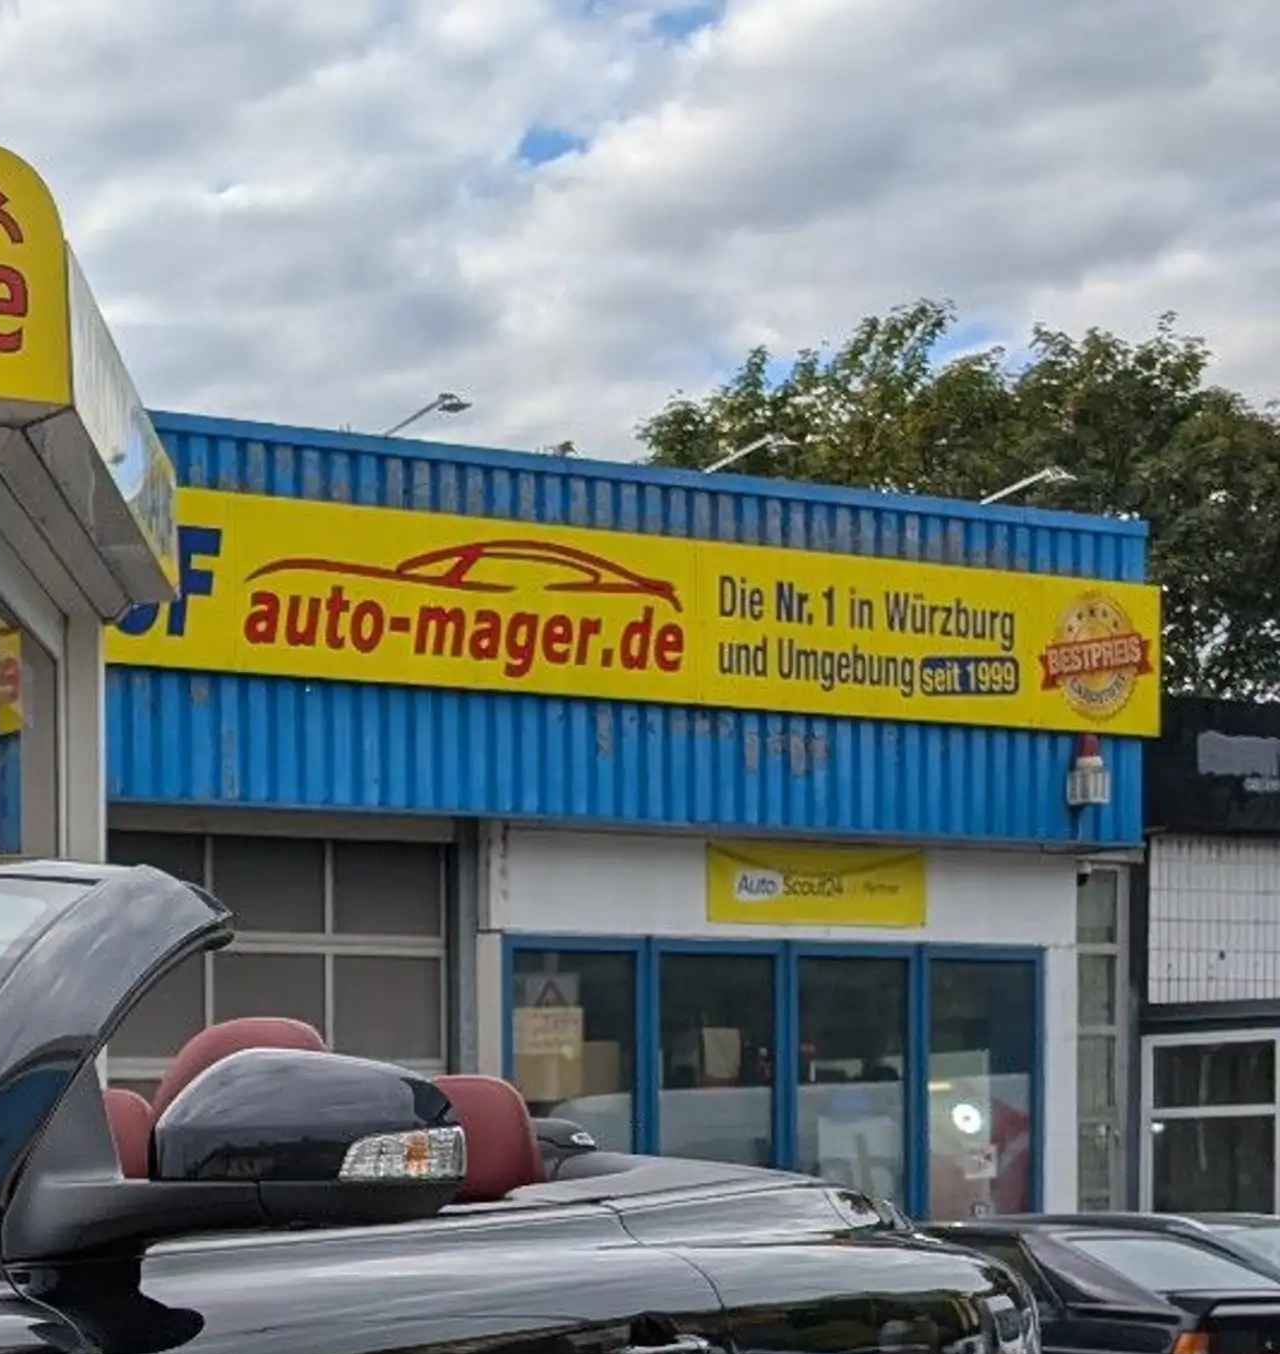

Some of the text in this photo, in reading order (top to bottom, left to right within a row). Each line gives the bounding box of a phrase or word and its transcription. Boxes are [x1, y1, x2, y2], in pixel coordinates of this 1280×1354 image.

[243, 583, 685, 678] auto-mager.de
[718, 575, 1016, 652] Die Nr. 1 in Würzburg
[718, 637, 1017, 697] und Umgebung seit 1999
[1046, 636, 1142, 676] BESTPREIS
